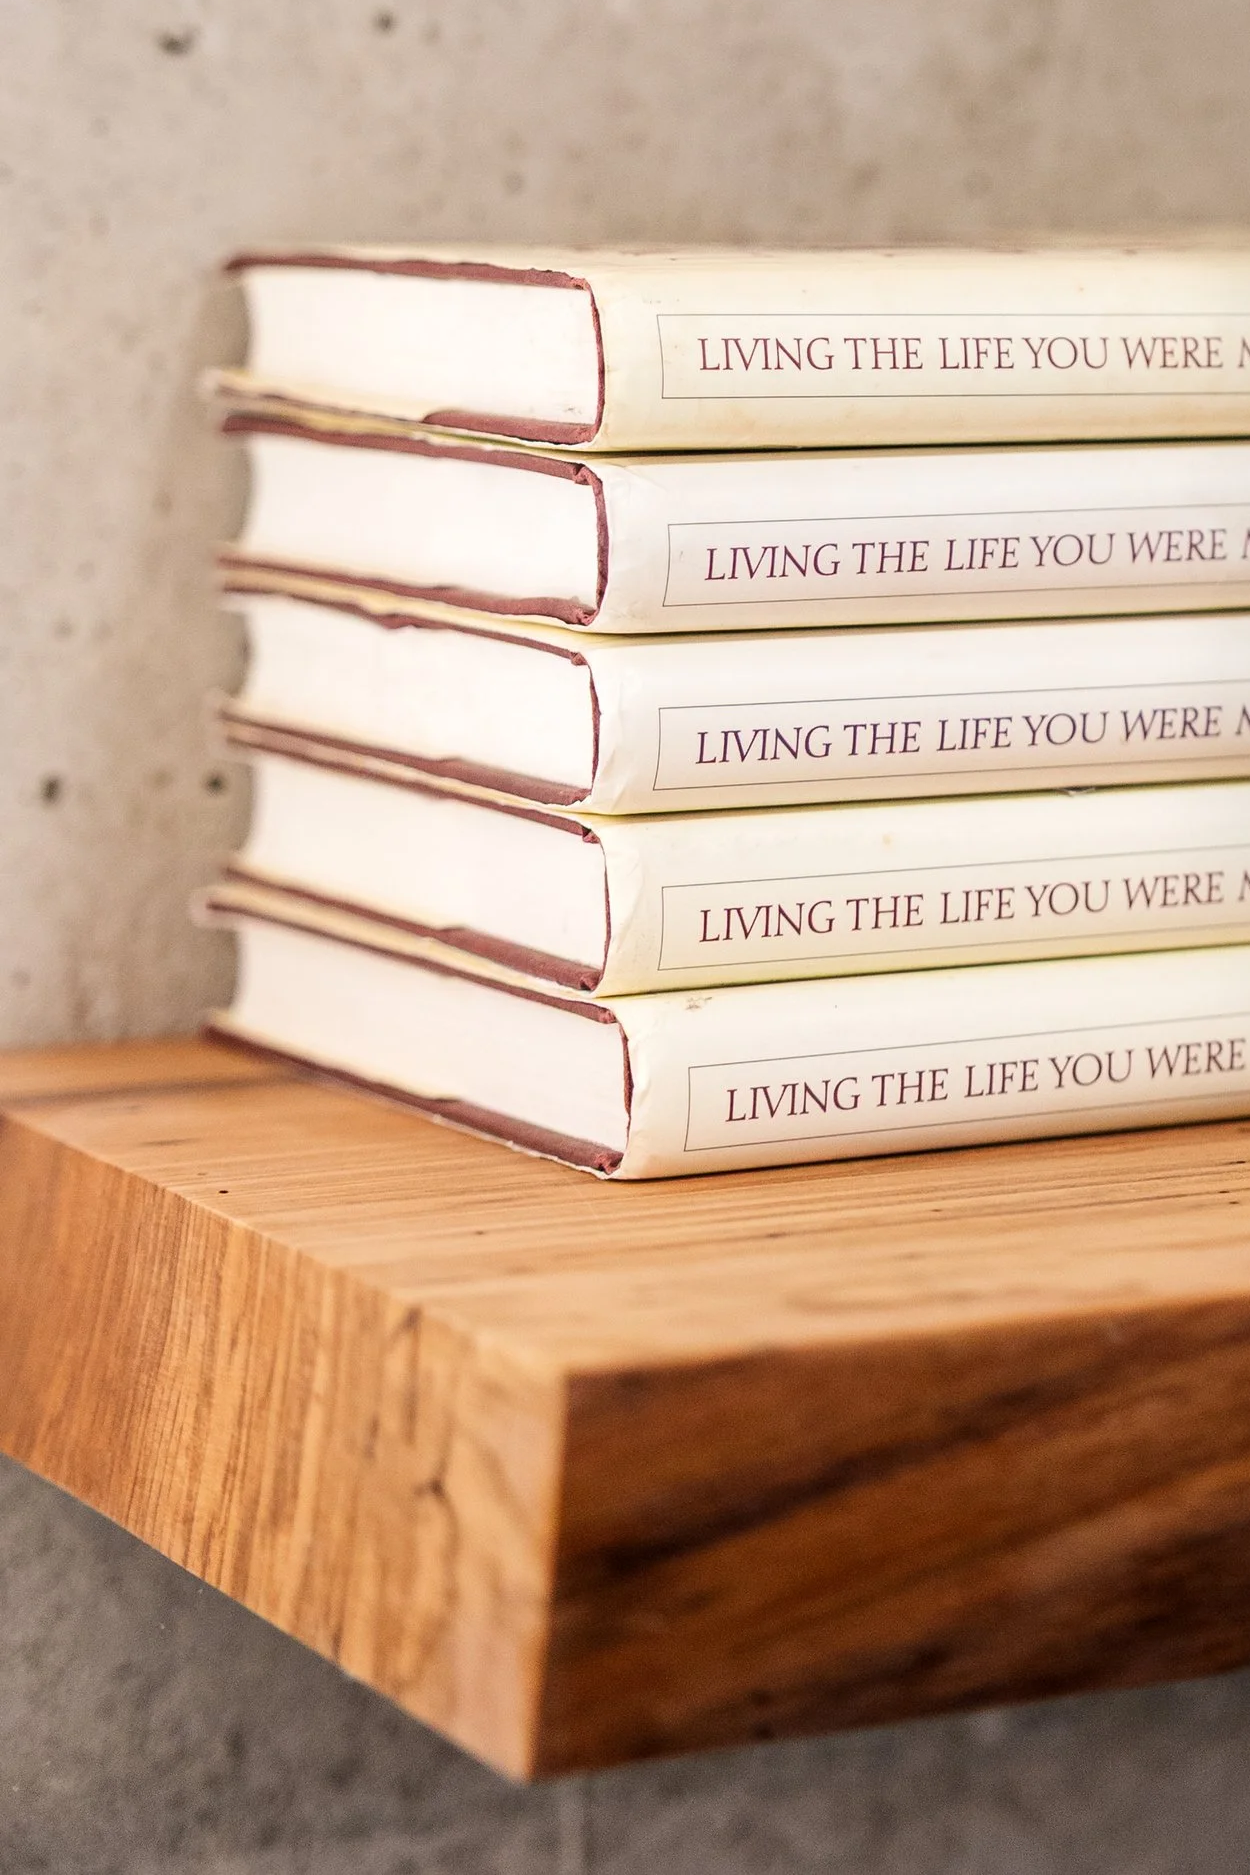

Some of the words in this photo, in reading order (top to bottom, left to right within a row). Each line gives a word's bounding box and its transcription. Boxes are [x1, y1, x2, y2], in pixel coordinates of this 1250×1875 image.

[698, 337, 834, 371] LIVING
[843, 338, 923, 370] THE
[939, 337, 1014, 369] LIFE
[1022, 337, 1108, 369] YOU
[1120, 337, 1223, 369] WERE
[705, 543, 840, 580] LIVING
[852, 540, 929, 574] THE
[944, 537, 1020, 571] LIFE
[1030, 533, 1115, 567] YOU
[1127, 528, 1227, 563] WERE
[696, 725, 831, 764] LIVING
[843, 721, 921, 756] THE
[937, 716, 1012, 751] LIFE
[1022, 712, 1108, 746] YOU
[1121, 706, 1222, 742] WERE
[700, 900, 835, 942] LIVING
[846, 894, 923, 931] THE
[940, 887, 1015, 924] LIFE
[1025, 880, 1110, 917] YOU
[1123, 871, 1224, 909] WERE
[726, 1077, 860, 1122] LIVING
[871, 1068, 948, 1107] THE
[965, 1059, 1039, 1098] LIFE
[1049, 1049, 1133, 1089] YOU
[1146, 1038, 1246, 1079] WERE
